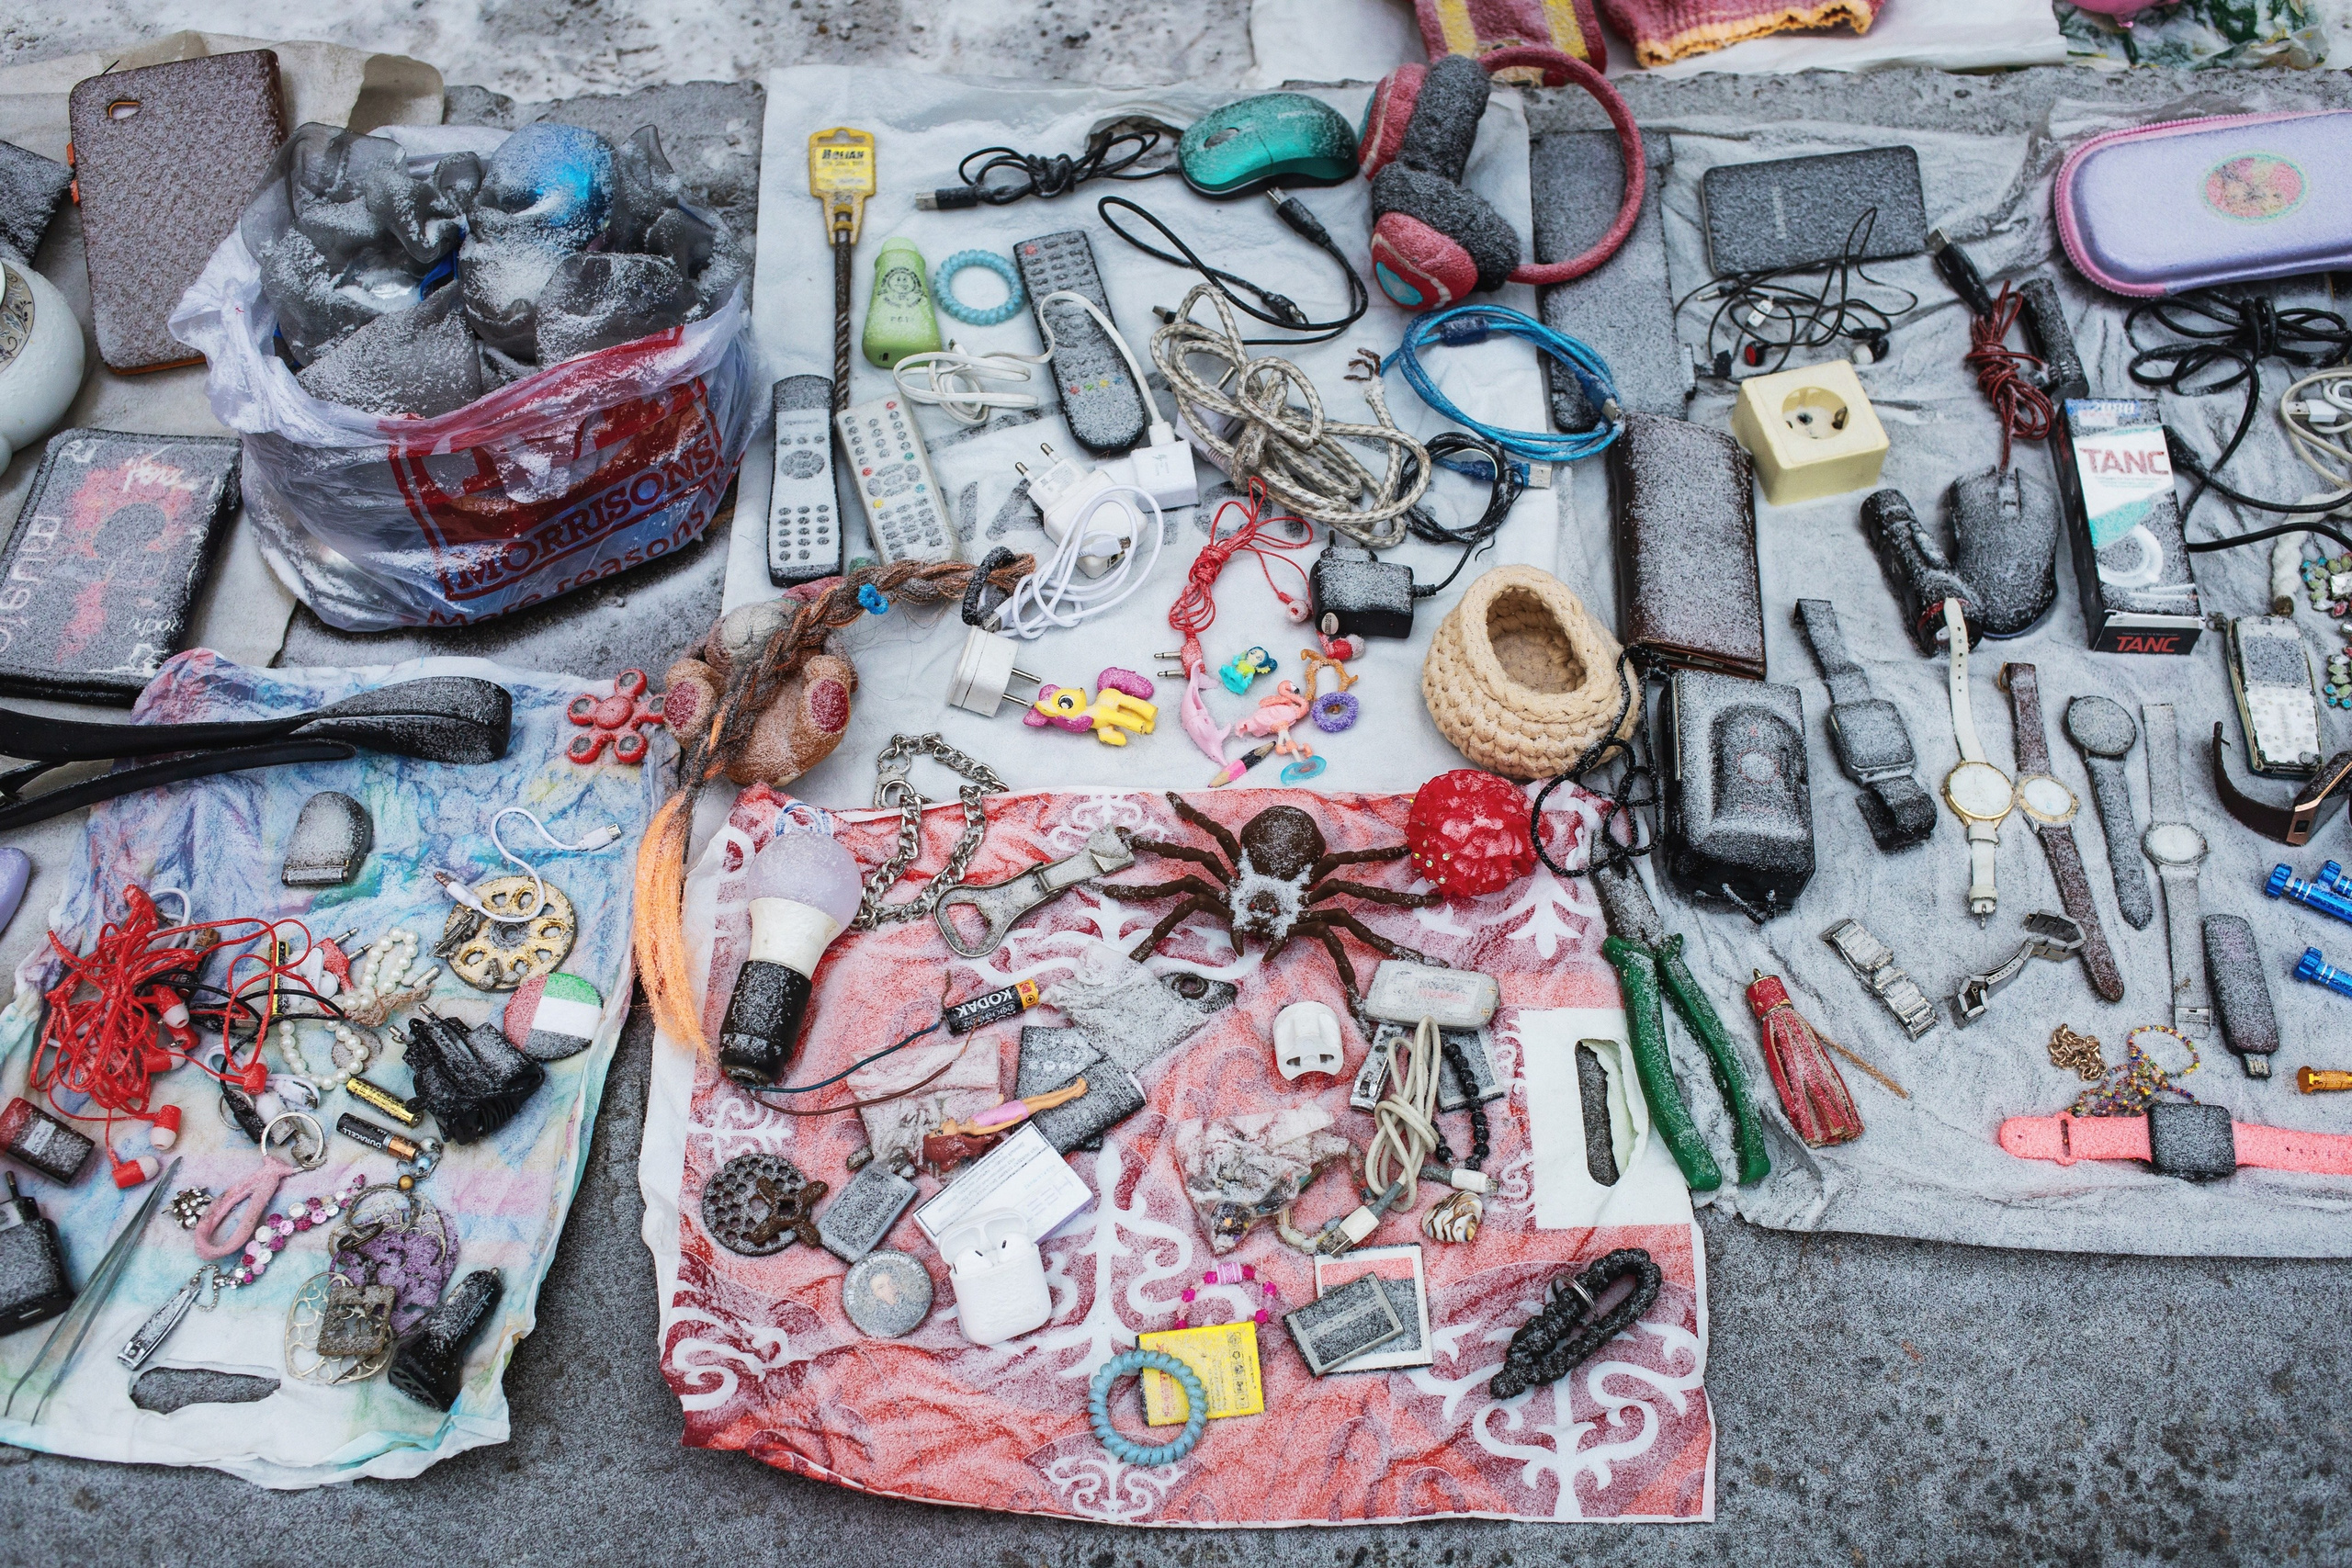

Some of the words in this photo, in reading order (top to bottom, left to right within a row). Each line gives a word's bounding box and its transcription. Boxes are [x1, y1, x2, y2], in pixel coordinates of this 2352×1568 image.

[2079, 447, 2170, 476] TANC
[450, 434, 717, 591] MORRISONS
[2116, 636, 2181, 653] TANC
[956, 988, 1013, 1019] KODAK
[343, 1126, 382, 1149] DURACELL
